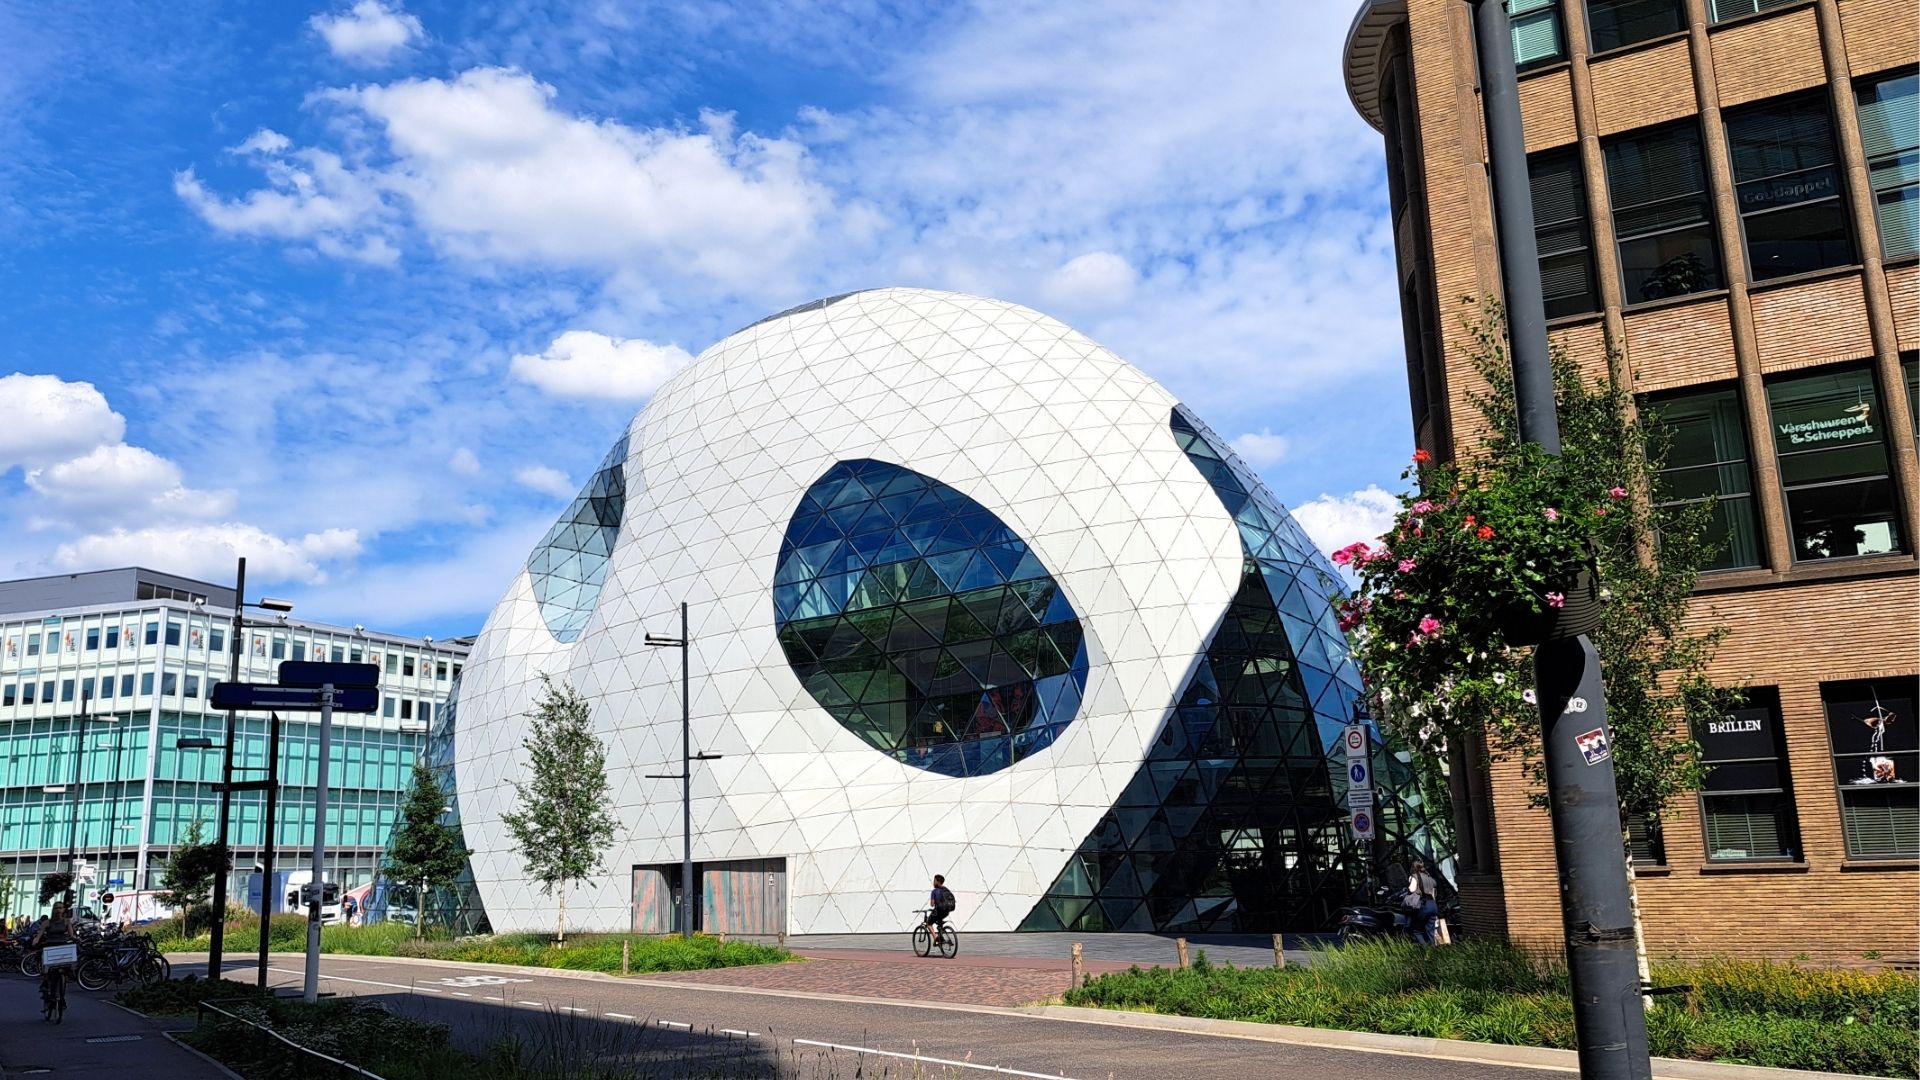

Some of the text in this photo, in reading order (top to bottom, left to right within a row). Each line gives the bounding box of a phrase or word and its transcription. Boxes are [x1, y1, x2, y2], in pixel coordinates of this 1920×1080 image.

[1744, 177, 1831, 203] Goudappel
[1779, 417, 1856, 435] Verschuuren
[1790, 425, 1874, 445] & Schreppers
[1708, 719, 1762, 734] BRILLEN
